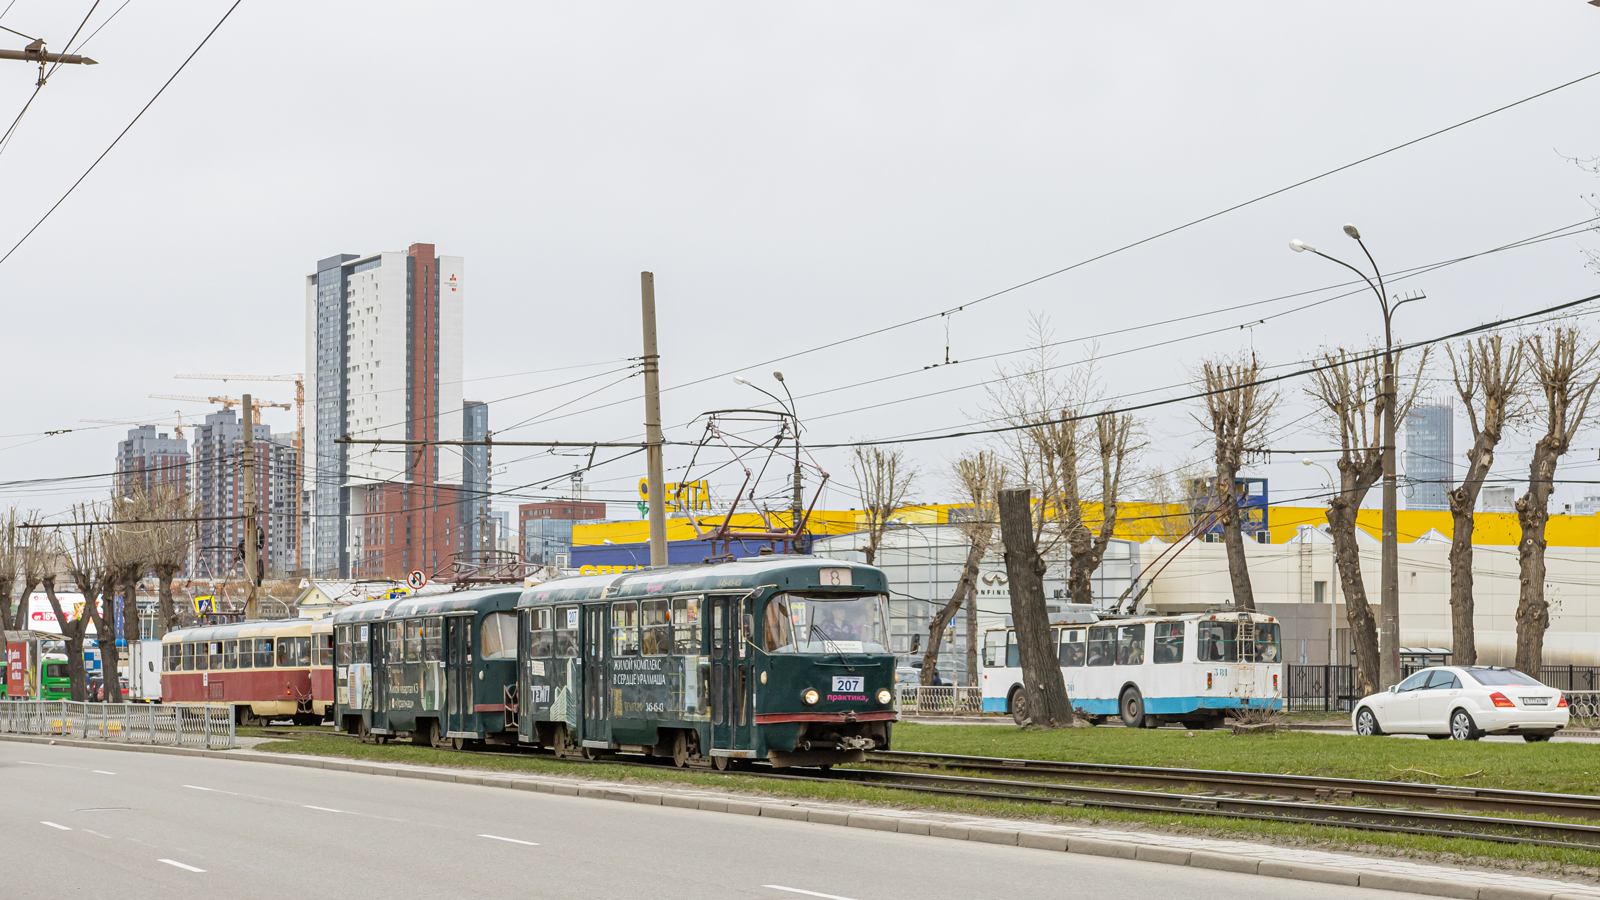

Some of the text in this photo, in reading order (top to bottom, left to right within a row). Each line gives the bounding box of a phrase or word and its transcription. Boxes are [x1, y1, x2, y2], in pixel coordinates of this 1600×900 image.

[664, 480, 712, 512] ЕНТА
[830, 570, 841, 586] 8
[568, 611, 577, 623] 207
[613, 657, 662, 671] ЖИЛОЙ КОМПЛЕКС
[1213, 668, 1228, 677] 381
[613, 673, 666, 686] В СЕРДЦЕ УРАЛМАША
[837, 680, 859, 692] 207
[530, 685, 550, 703] ТЕМП
[827, 693, 869, 703] практика,
